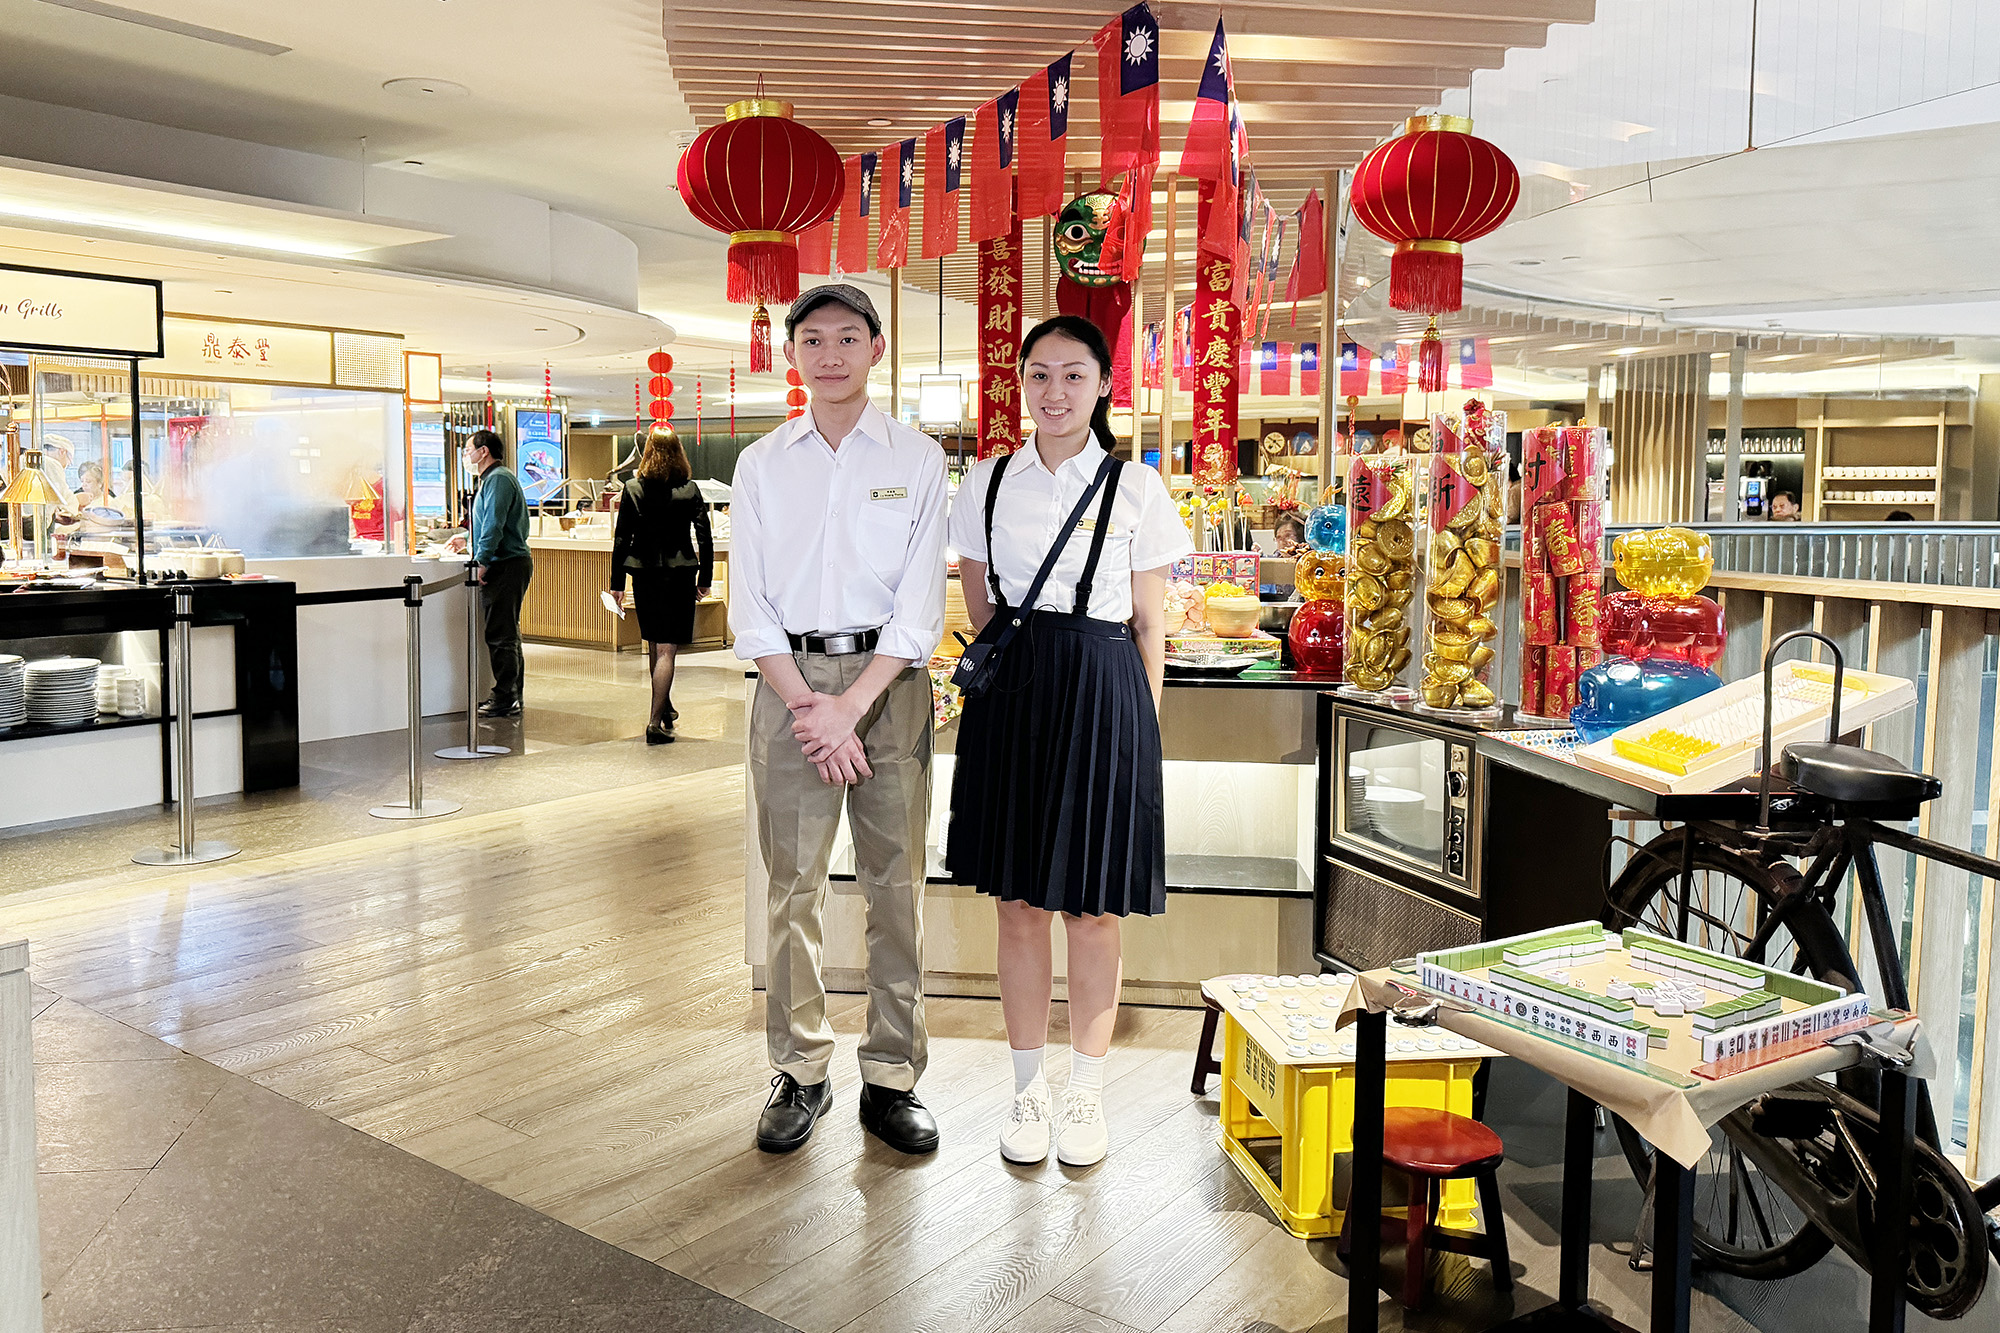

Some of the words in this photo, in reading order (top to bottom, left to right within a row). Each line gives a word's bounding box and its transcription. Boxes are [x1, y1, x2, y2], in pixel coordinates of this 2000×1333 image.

[17, 298, 63, 320] Grills
[202, 332, 270, 361] 鼎泰豐
[1200, 260, 1234, 441] 富貴慶豐年
[1545, 518, 1577, 556] 春
[1572, 588, 1600, 627] 春
[1591, 1029, 1602, 1042] 西
[1608, 1034, 1619, 1048] 西
